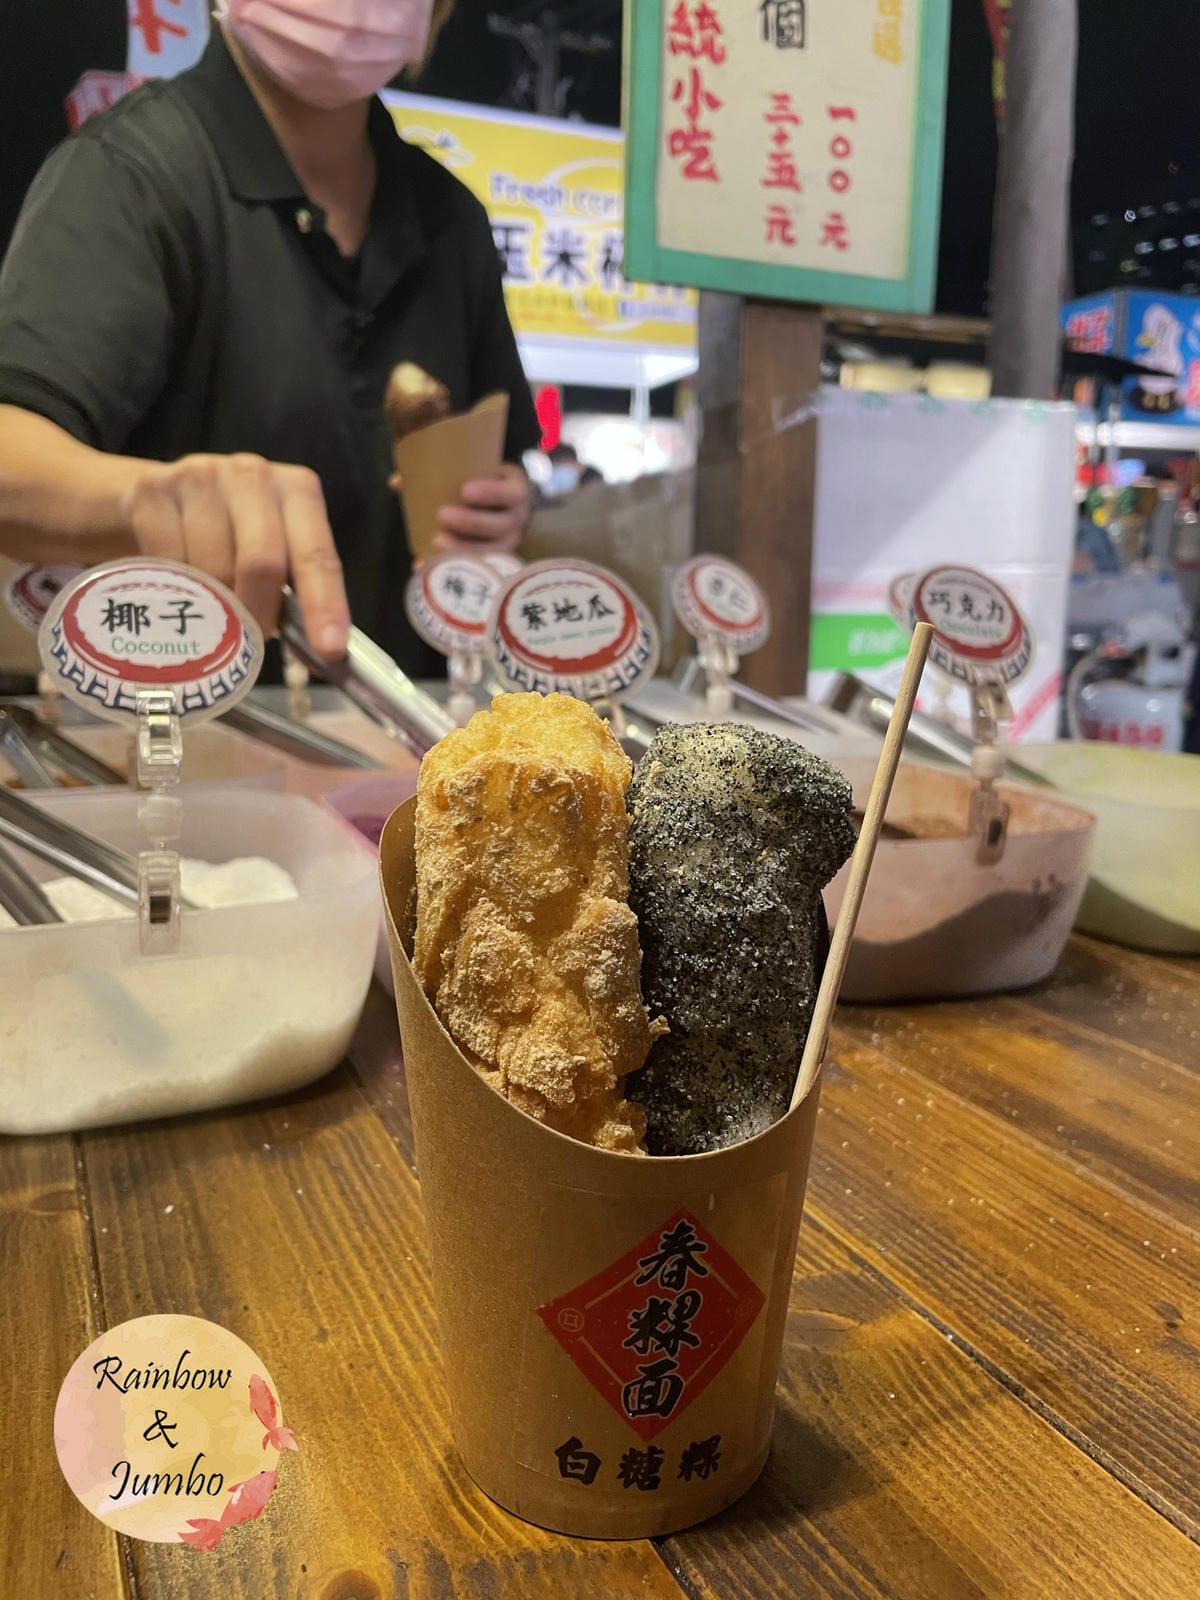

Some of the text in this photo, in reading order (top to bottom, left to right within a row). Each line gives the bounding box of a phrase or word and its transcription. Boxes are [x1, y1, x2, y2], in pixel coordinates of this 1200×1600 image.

[490, 172, 564, 208] Fresh
[100, 598, 204, 636] 椰子
[519, 594, 616, 631] 紫地瓜
[928, 591, 1004, 623] 巧克力
[110, 636, 200, 655] Coconut
[621, 1217, 709, 1419] 春粿面
[554, 1435, 723, 1491] 白糖粿
